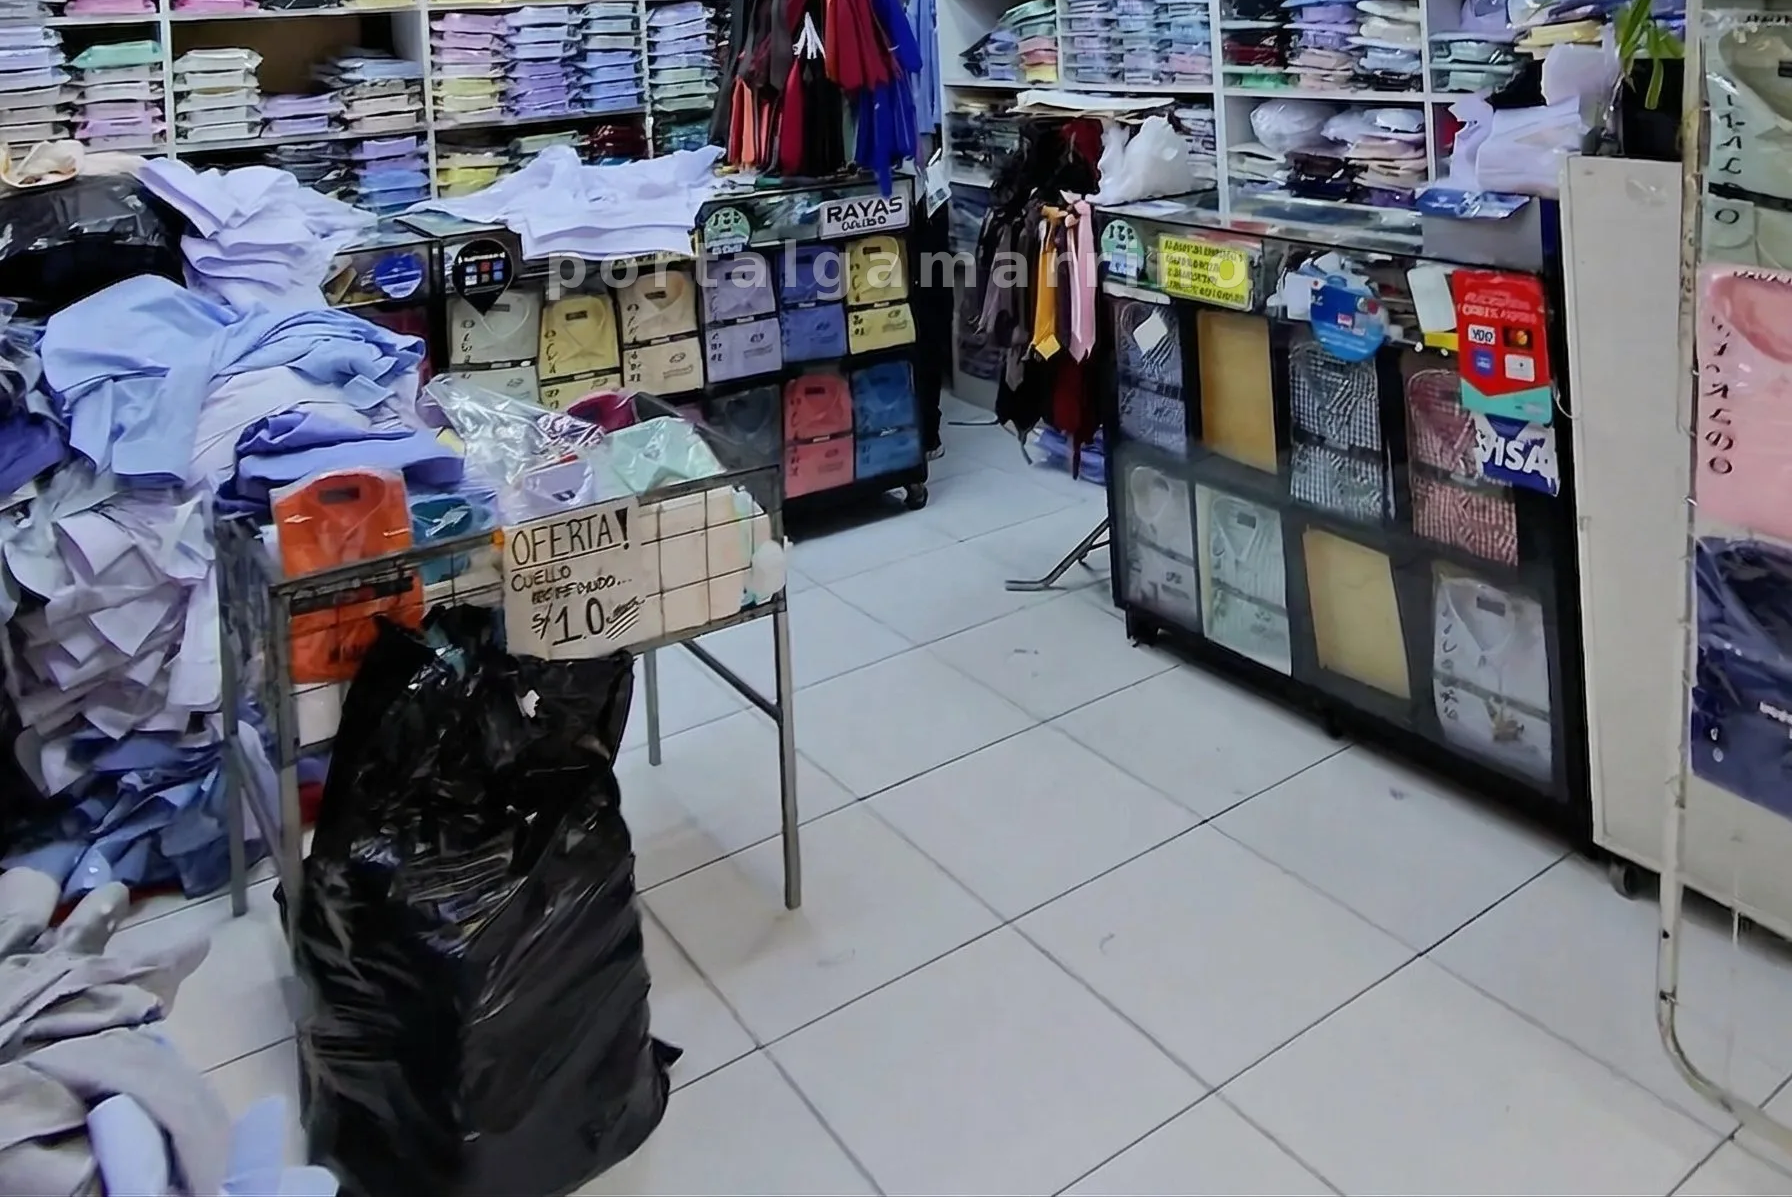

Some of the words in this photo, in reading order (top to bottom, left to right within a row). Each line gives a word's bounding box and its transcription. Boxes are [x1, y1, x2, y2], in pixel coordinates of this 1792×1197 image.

[827, 196, 903, 223] RAYAS
[1477, 436, 1554, 477] VISA
[512, 507, 629, 566] OFERTA!
[511, 565, 571, 592] CUELLO
